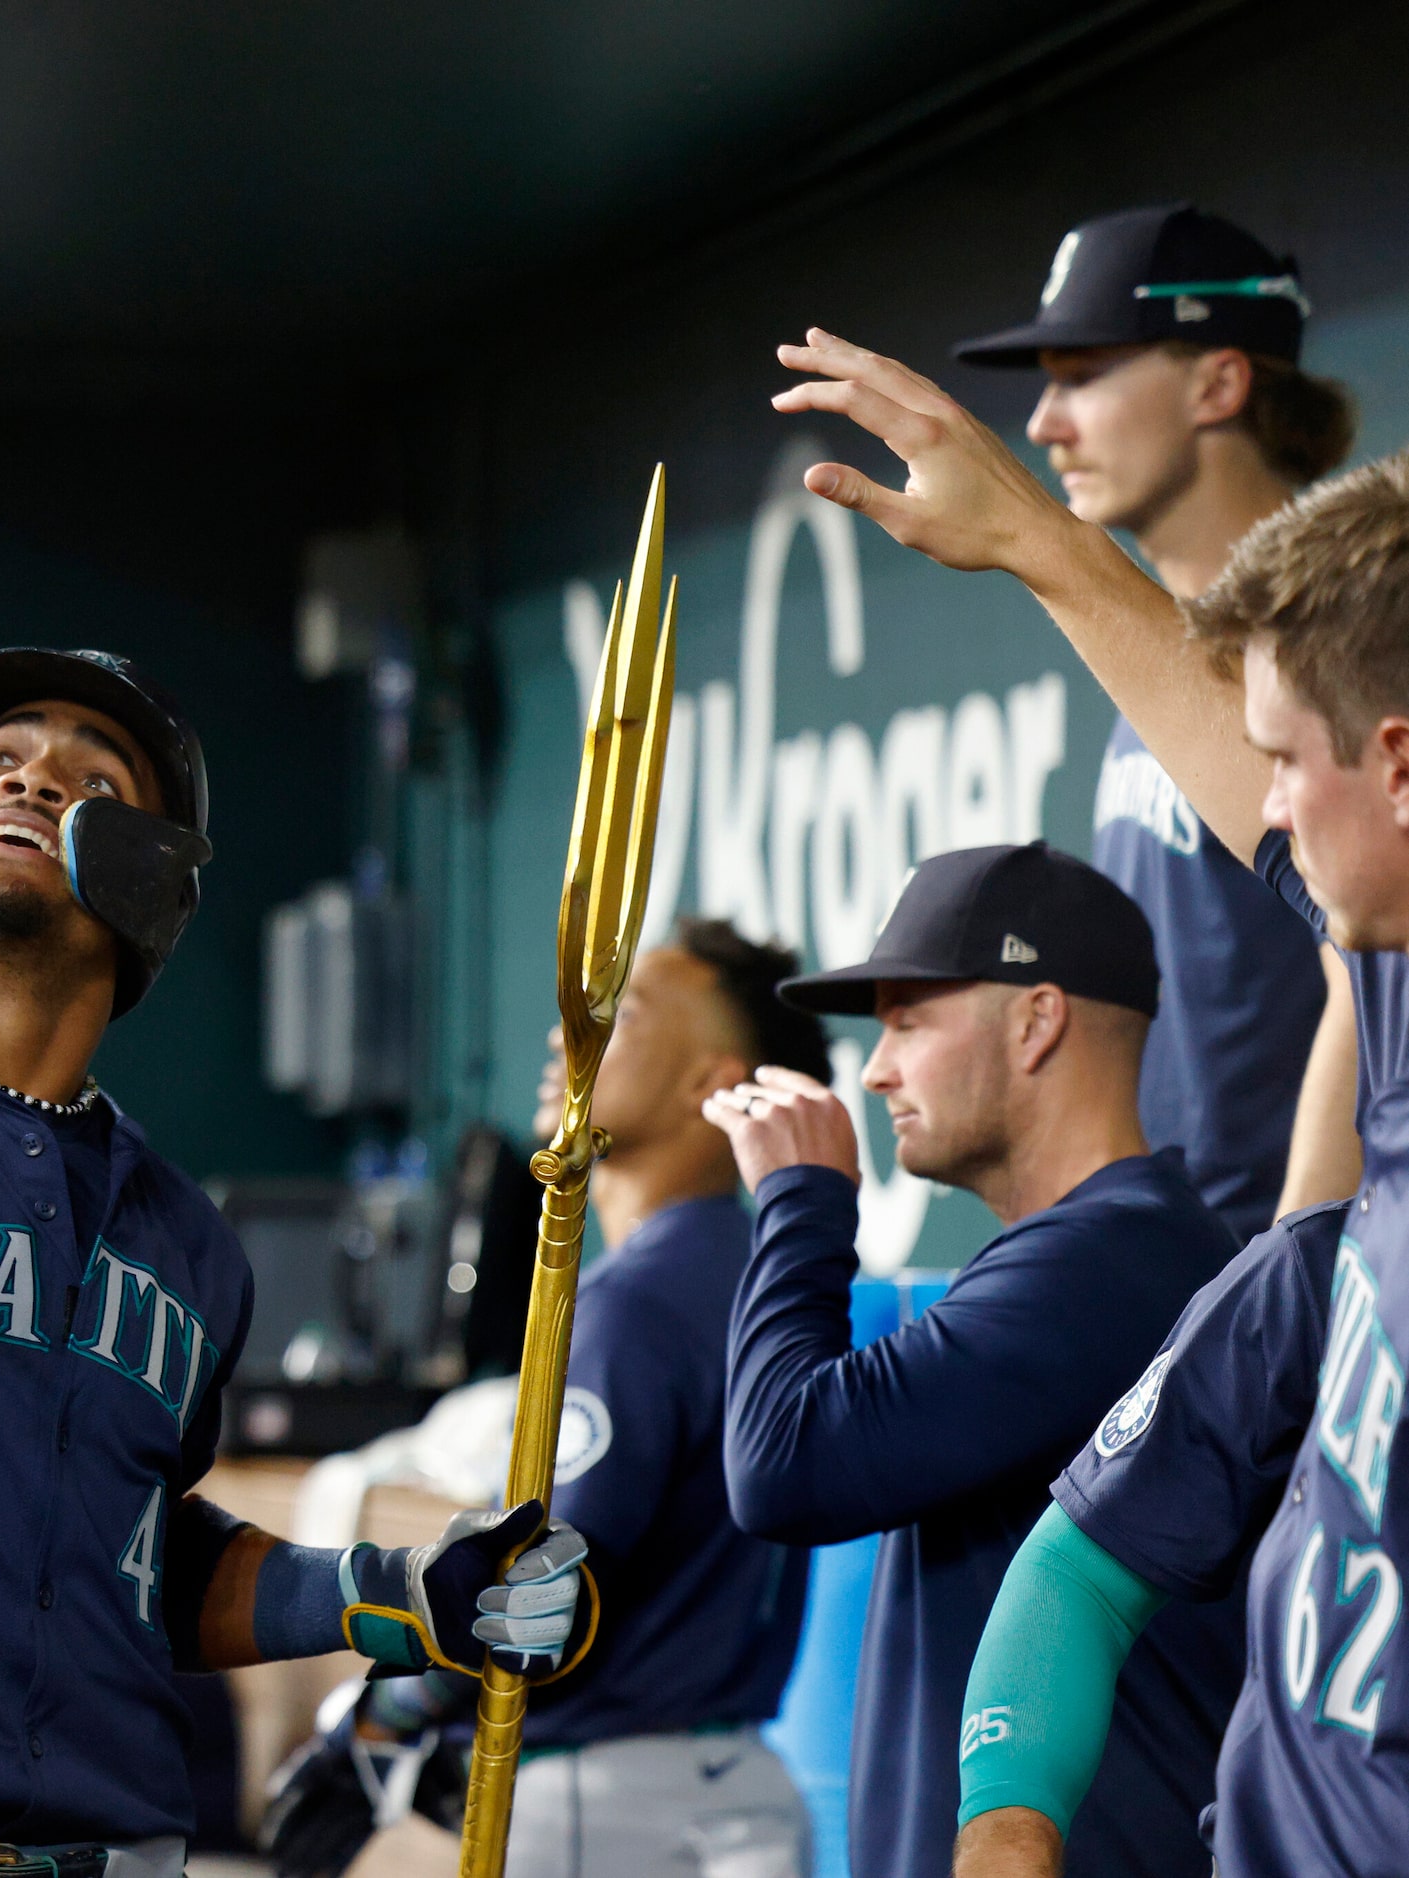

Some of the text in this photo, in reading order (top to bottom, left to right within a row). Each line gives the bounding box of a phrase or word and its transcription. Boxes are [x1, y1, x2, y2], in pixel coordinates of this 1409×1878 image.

[116, 1477, 168, 1633] 4
[1284, 1521, 1404, 1740] 62
[960, 1704, 1011, 1764] 25
